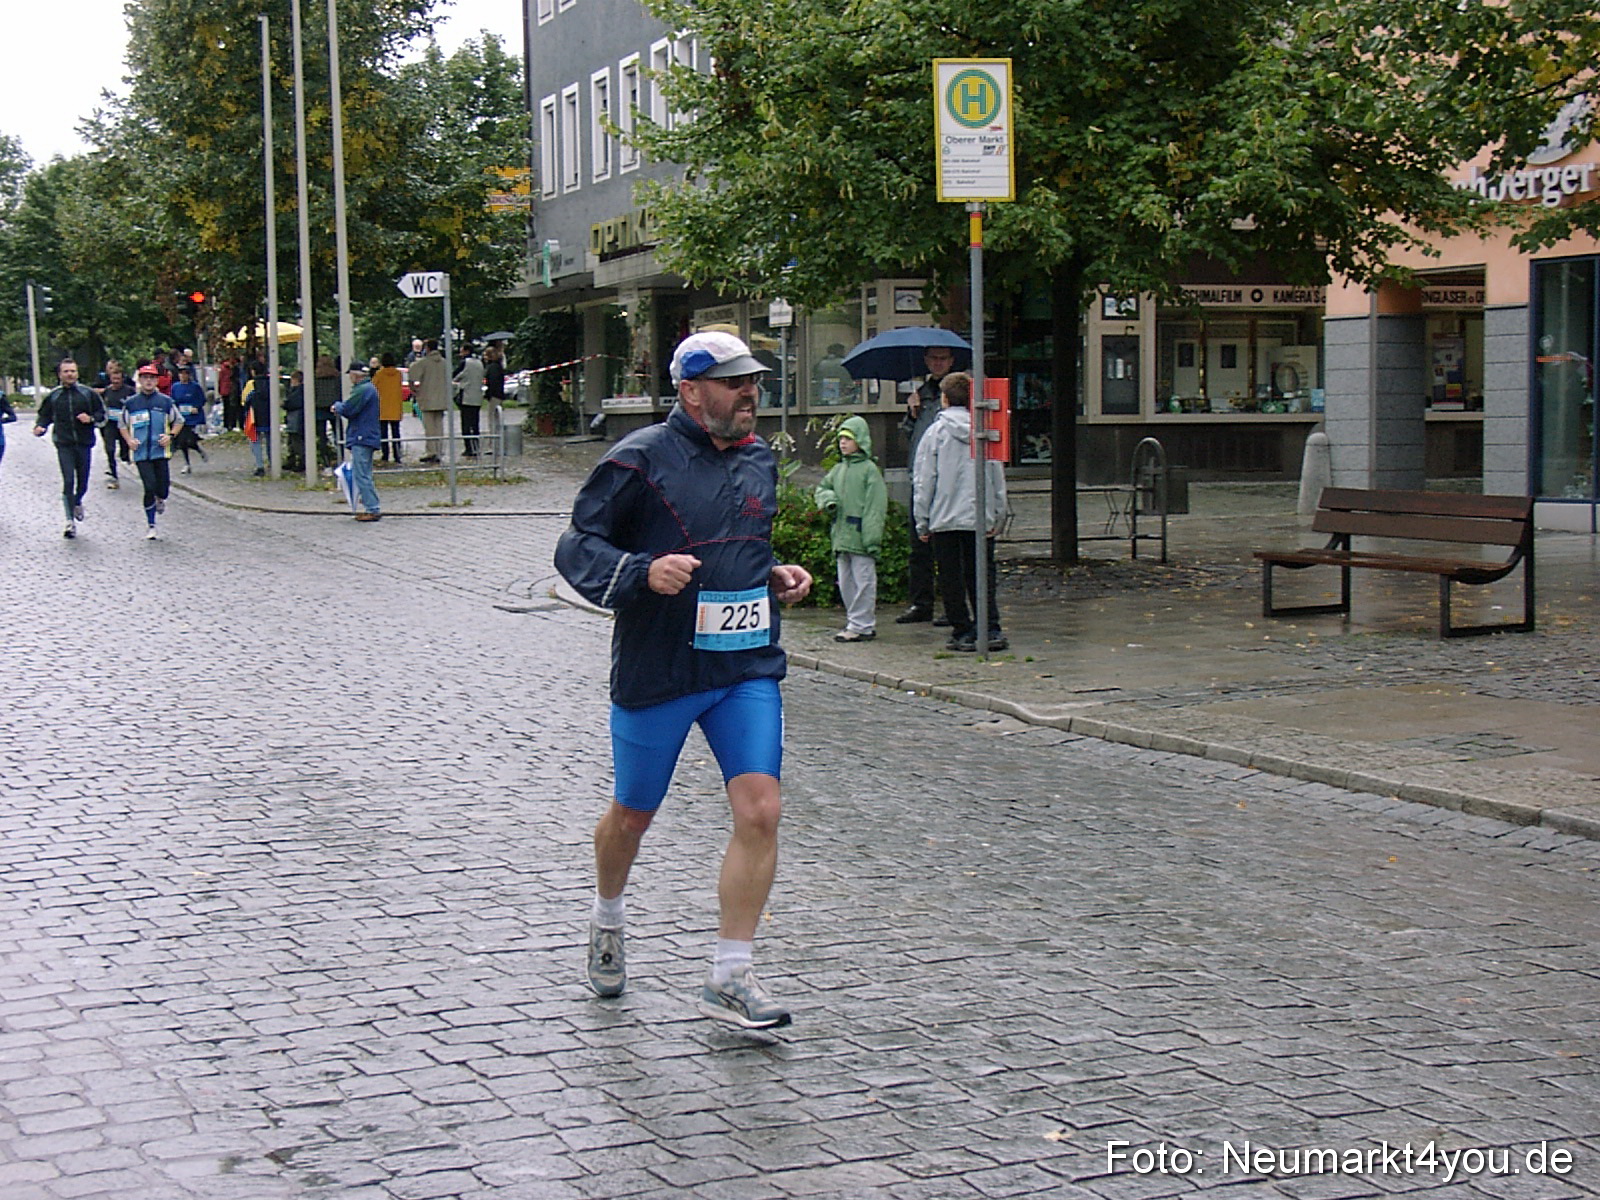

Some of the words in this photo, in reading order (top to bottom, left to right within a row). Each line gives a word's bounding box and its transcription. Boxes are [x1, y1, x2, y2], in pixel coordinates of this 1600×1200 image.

[961, 83, 986, 115] H
[945, 135, 976, 144] Oberer
[979, 135, 1003, 143] Markt
[411, 276, 437, 294] WC
[720, 602, 760, 631] 225
